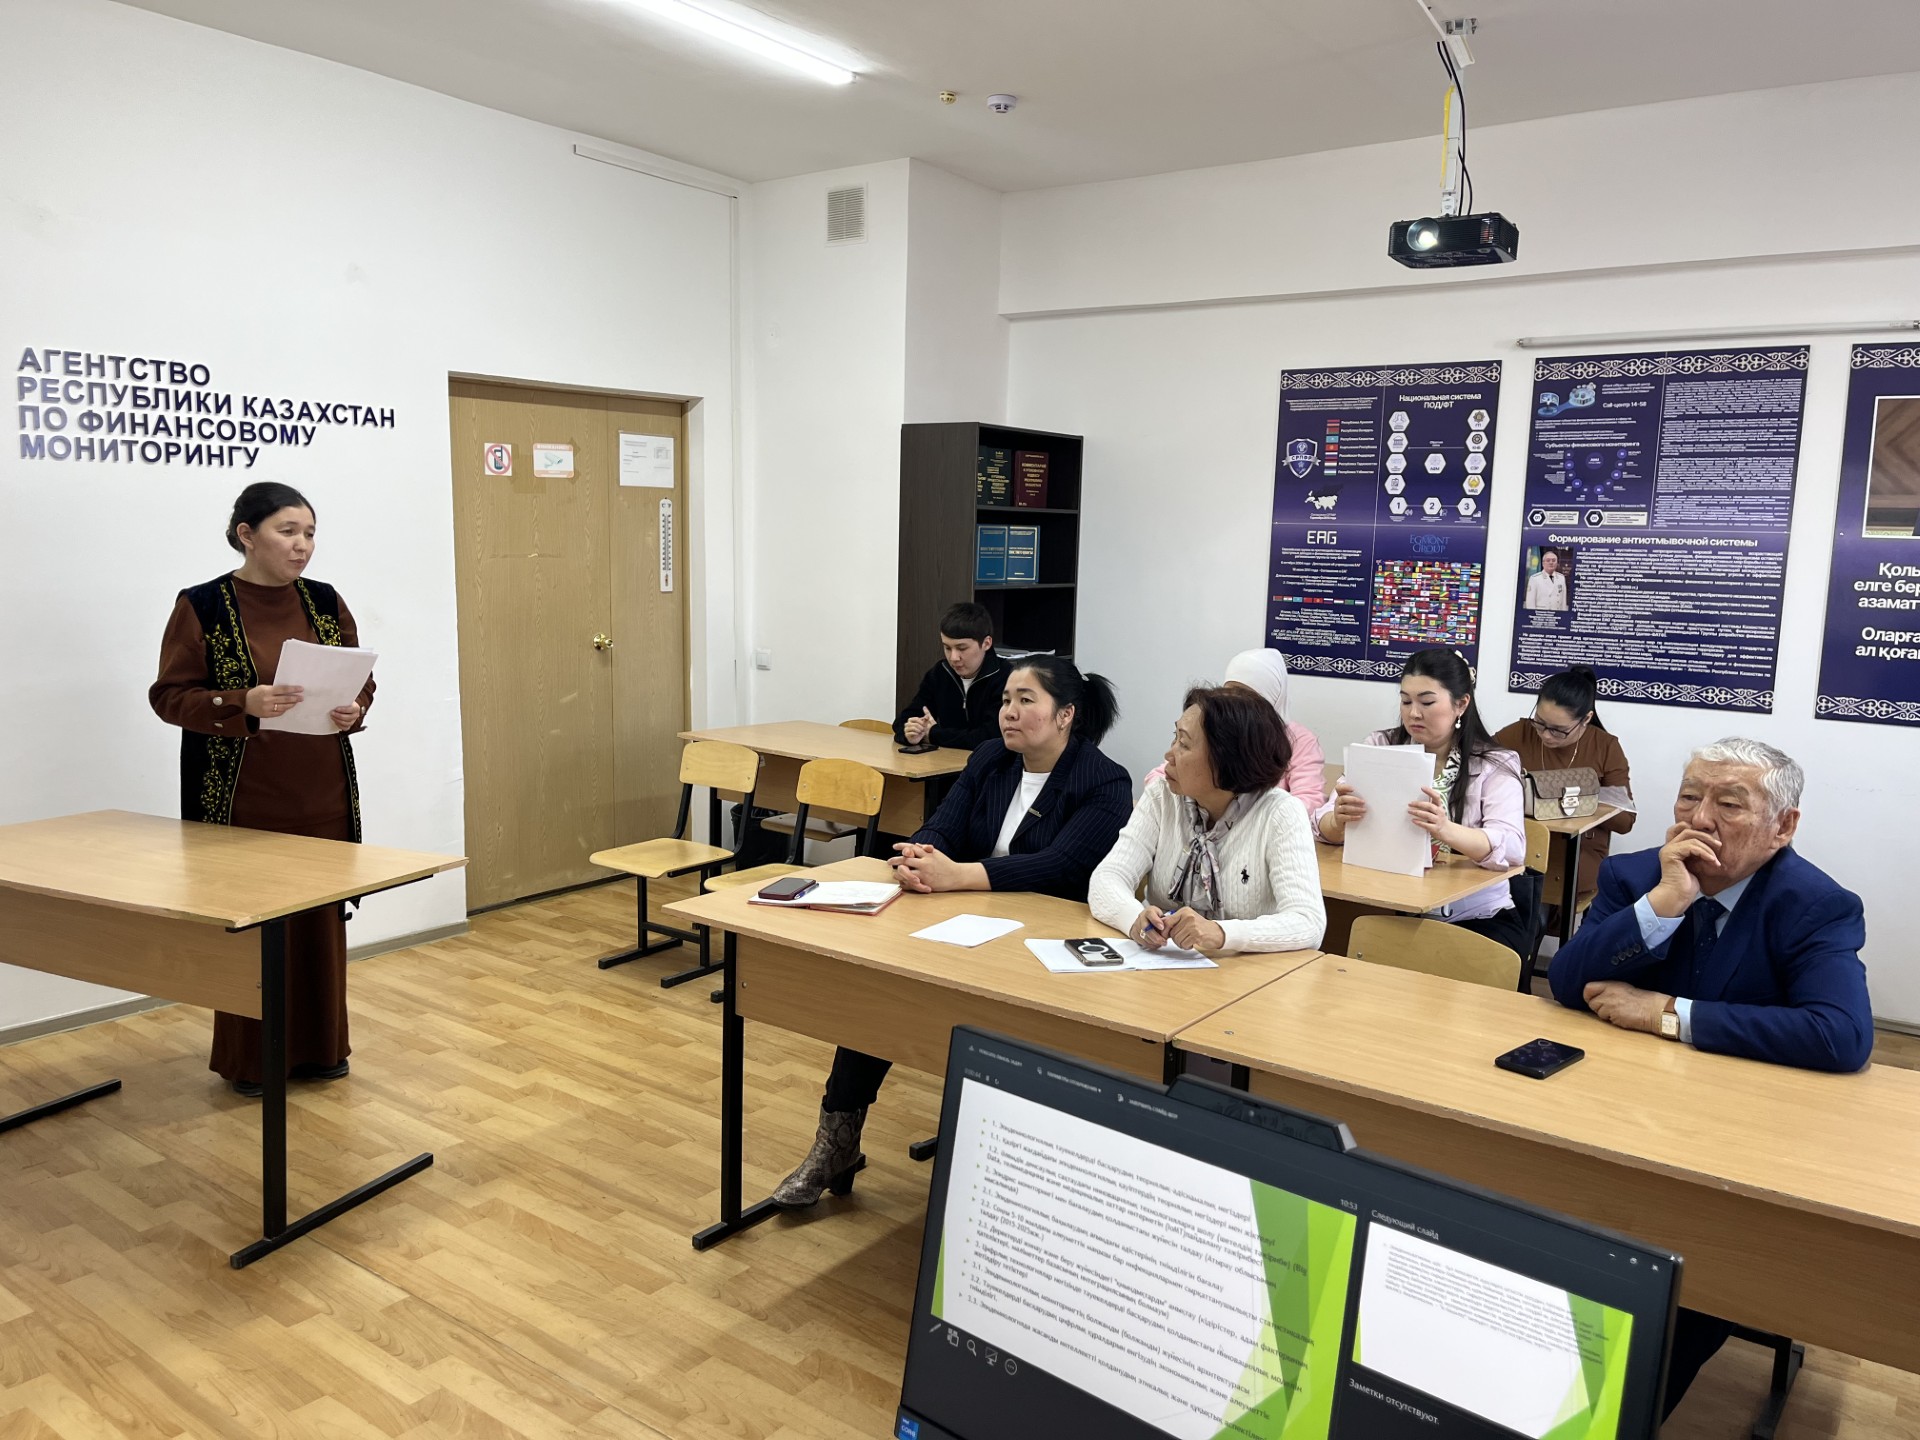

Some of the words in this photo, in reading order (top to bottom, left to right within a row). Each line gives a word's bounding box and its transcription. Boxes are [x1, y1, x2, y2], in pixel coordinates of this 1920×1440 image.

[17, 346, 211, 386] АГЕНТСТВО
[17, 376, 233, 416] РЕСПУБЛИКИ
[242, 396, 396, 429] КАЗАХСТАН
[1399, 394, 1450, 404] Национальная
[1450, 393, 1482, 401] система
[1424, 401, 1454, 410] ПОД/ФТ
[18, 405, 68, 431] ПО
[77, 408, 316, 446] ФИНАНСОВОМУ
[19, 434, 260, 468] МОНИТОРИНГУ
[1429, 502, 1435, 510] 2
[1307, 530, 1338, 545] EAG
[1410, 535, 1450, 545] EGMONT
[1548, 534, 1621, 545] Формирование
[1622, 536, 1708, 546] антиотмывочной
[1710, 539, 1758, 547] системы
[1854, 580, 1892, 592] елге
[1855, 645, 1876, 656] ал
[1340, 1198, 1358, 1210] 10:53
[1371, 1209, 1416, 1232] Следующий
[1417, 1226, 1439, 1240] слайд
[1349, 1378, 1384, 1401] Заметки
[1386, 1395, 1440, 1425] отсутствуют.
